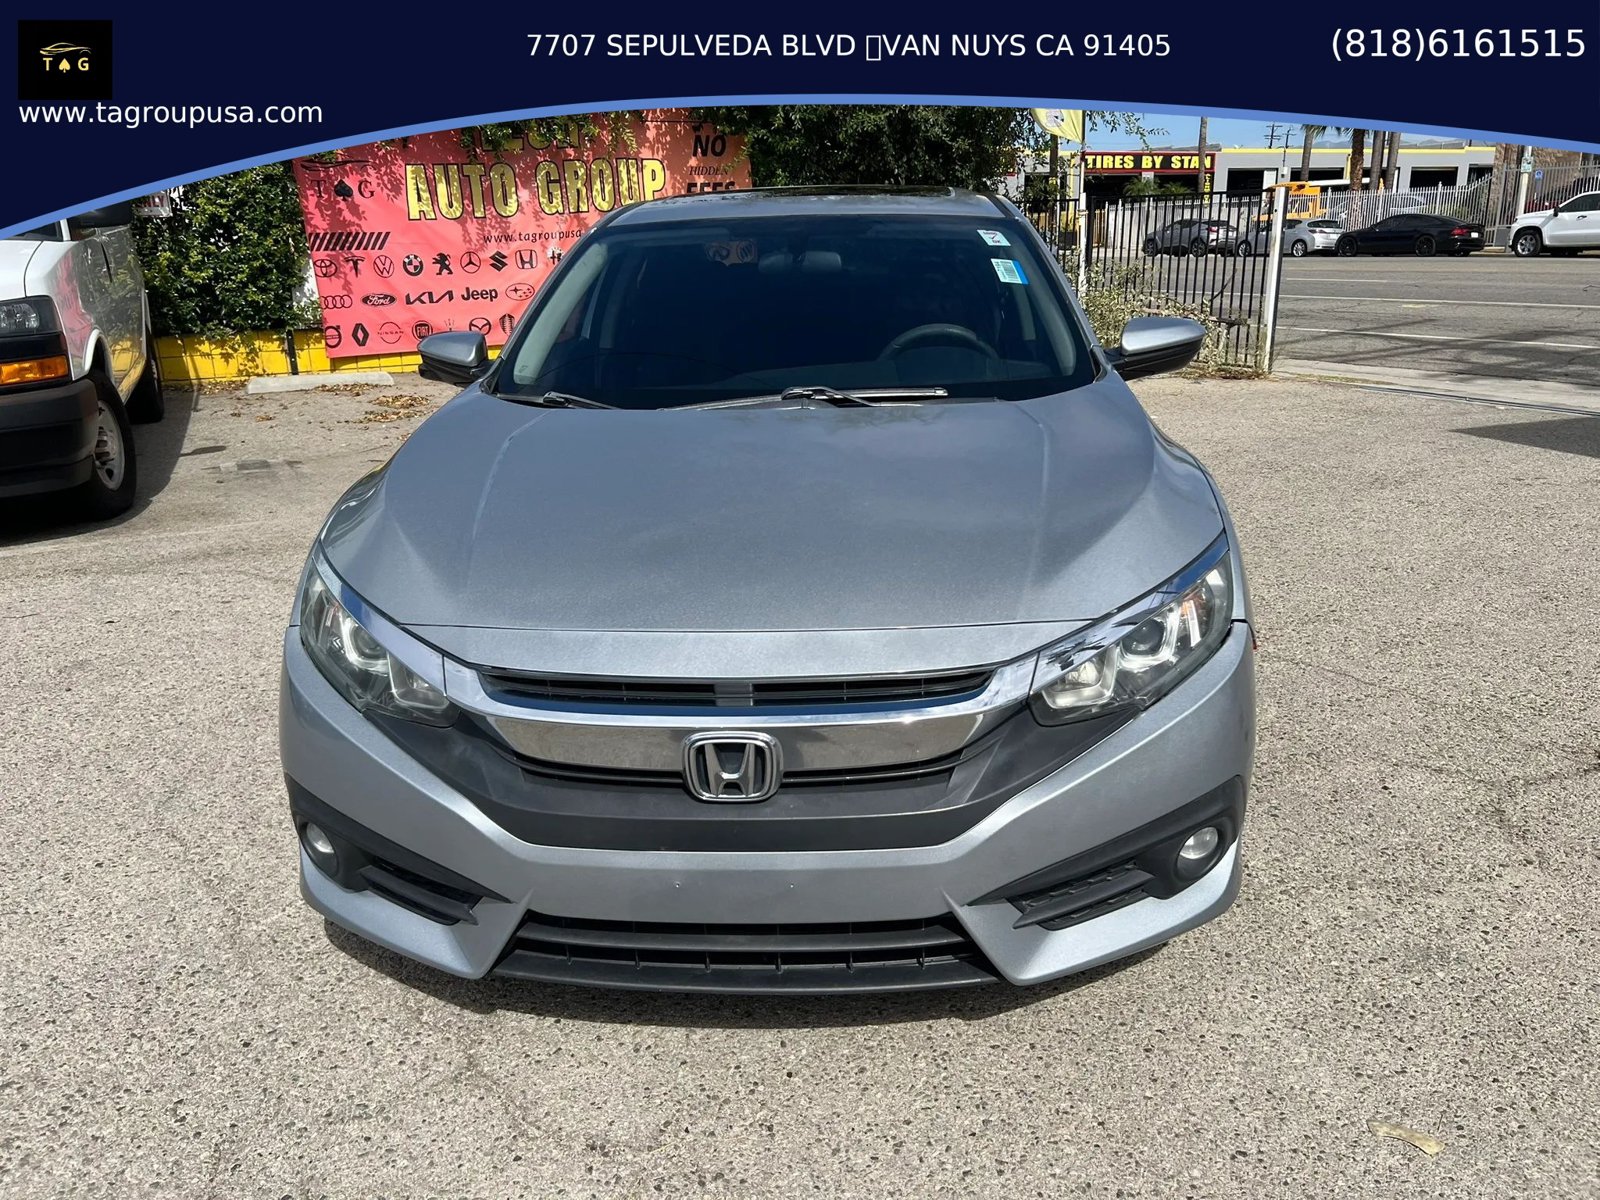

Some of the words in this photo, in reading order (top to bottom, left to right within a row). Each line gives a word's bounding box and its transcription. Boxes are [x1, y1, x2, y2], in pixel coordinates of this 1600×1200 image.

[692, 134, 727, 157] NO
[1085, 155, 1134, 169] TIRES
[1141, 155, 1164, 169] BY
[1171, 156, 1211, 169] STAN
[405, 163, 519, 220] AUTO
[535, 158, 665, 214] GROUP
[461, 287, 498, 302] Jeep
